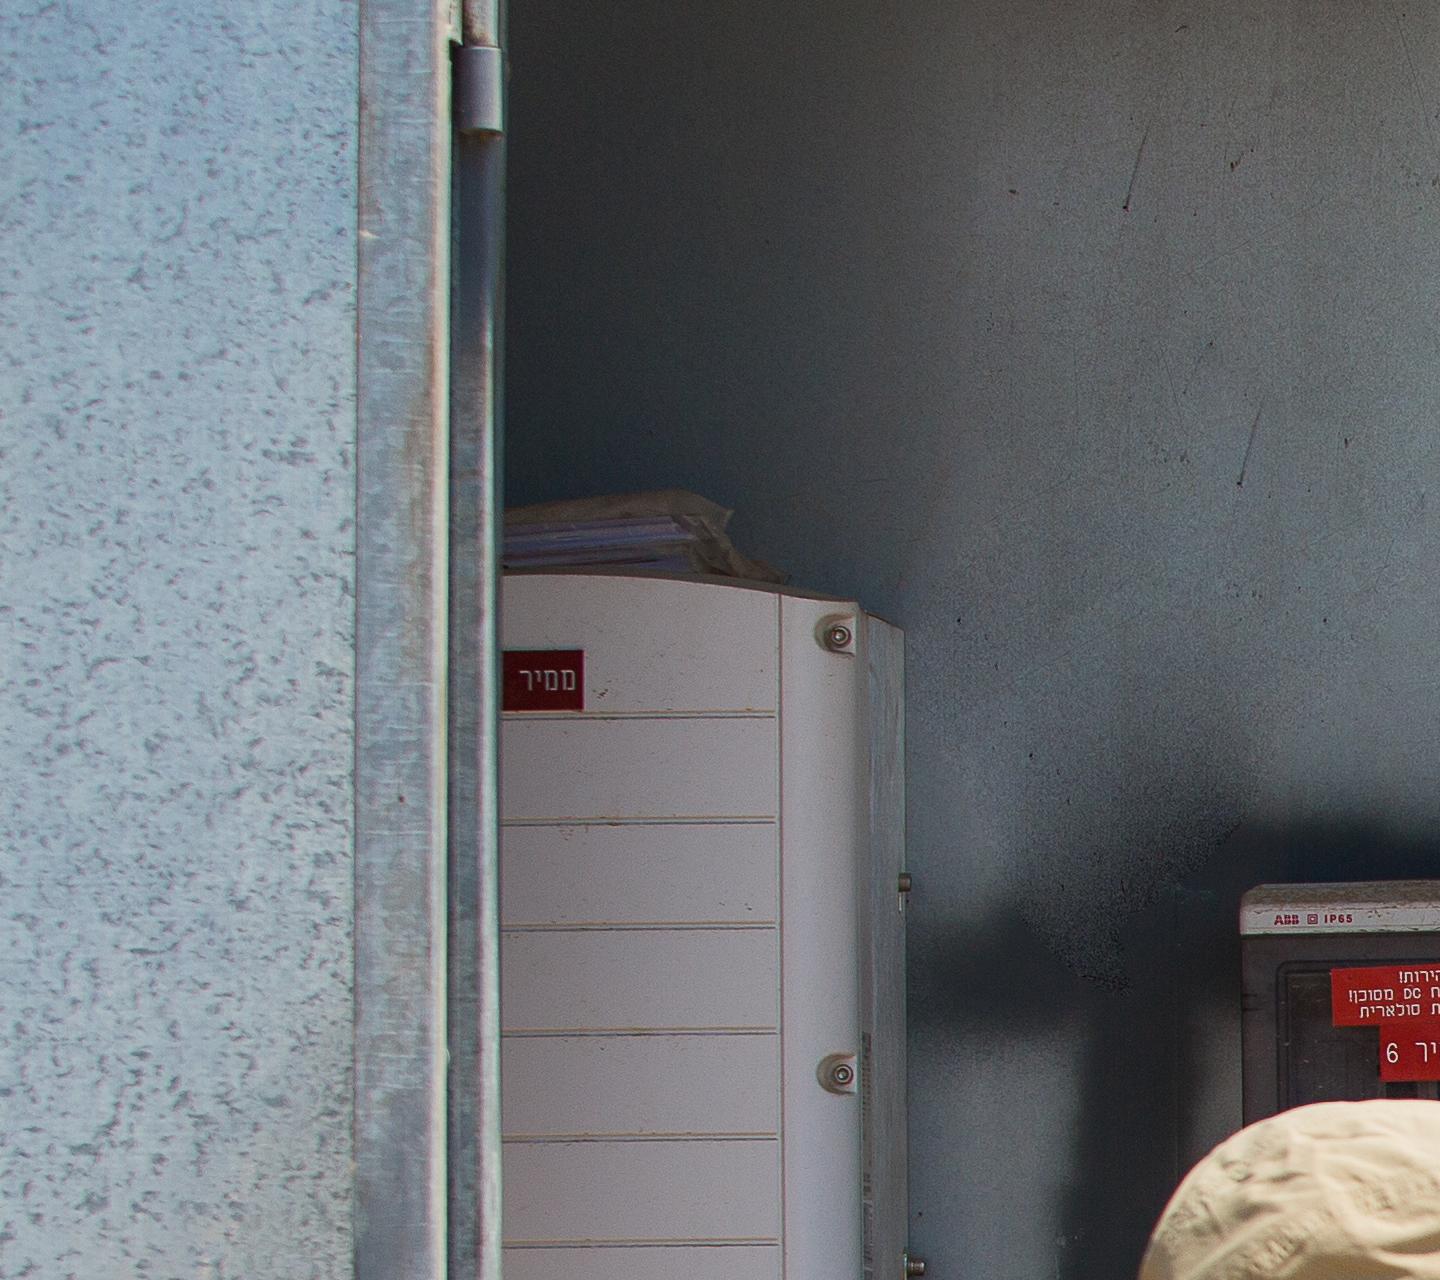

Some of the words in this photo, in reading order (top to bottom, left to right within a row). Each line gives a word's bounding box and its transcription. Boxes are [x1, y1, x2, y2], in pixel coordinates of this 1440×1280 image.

[519, 668, 576, 692] ממיר
[1274, 914, 1299, 925] ABB
[1324, 914, 1353, 923] IP65
[1348, 988, 1394, 1003] מסוכן!
[1403, 987, 1421, 999] DC
[1359, 1003, 1421, 1019] סולארית
[1386, 1042, 1399, 1063] 6
